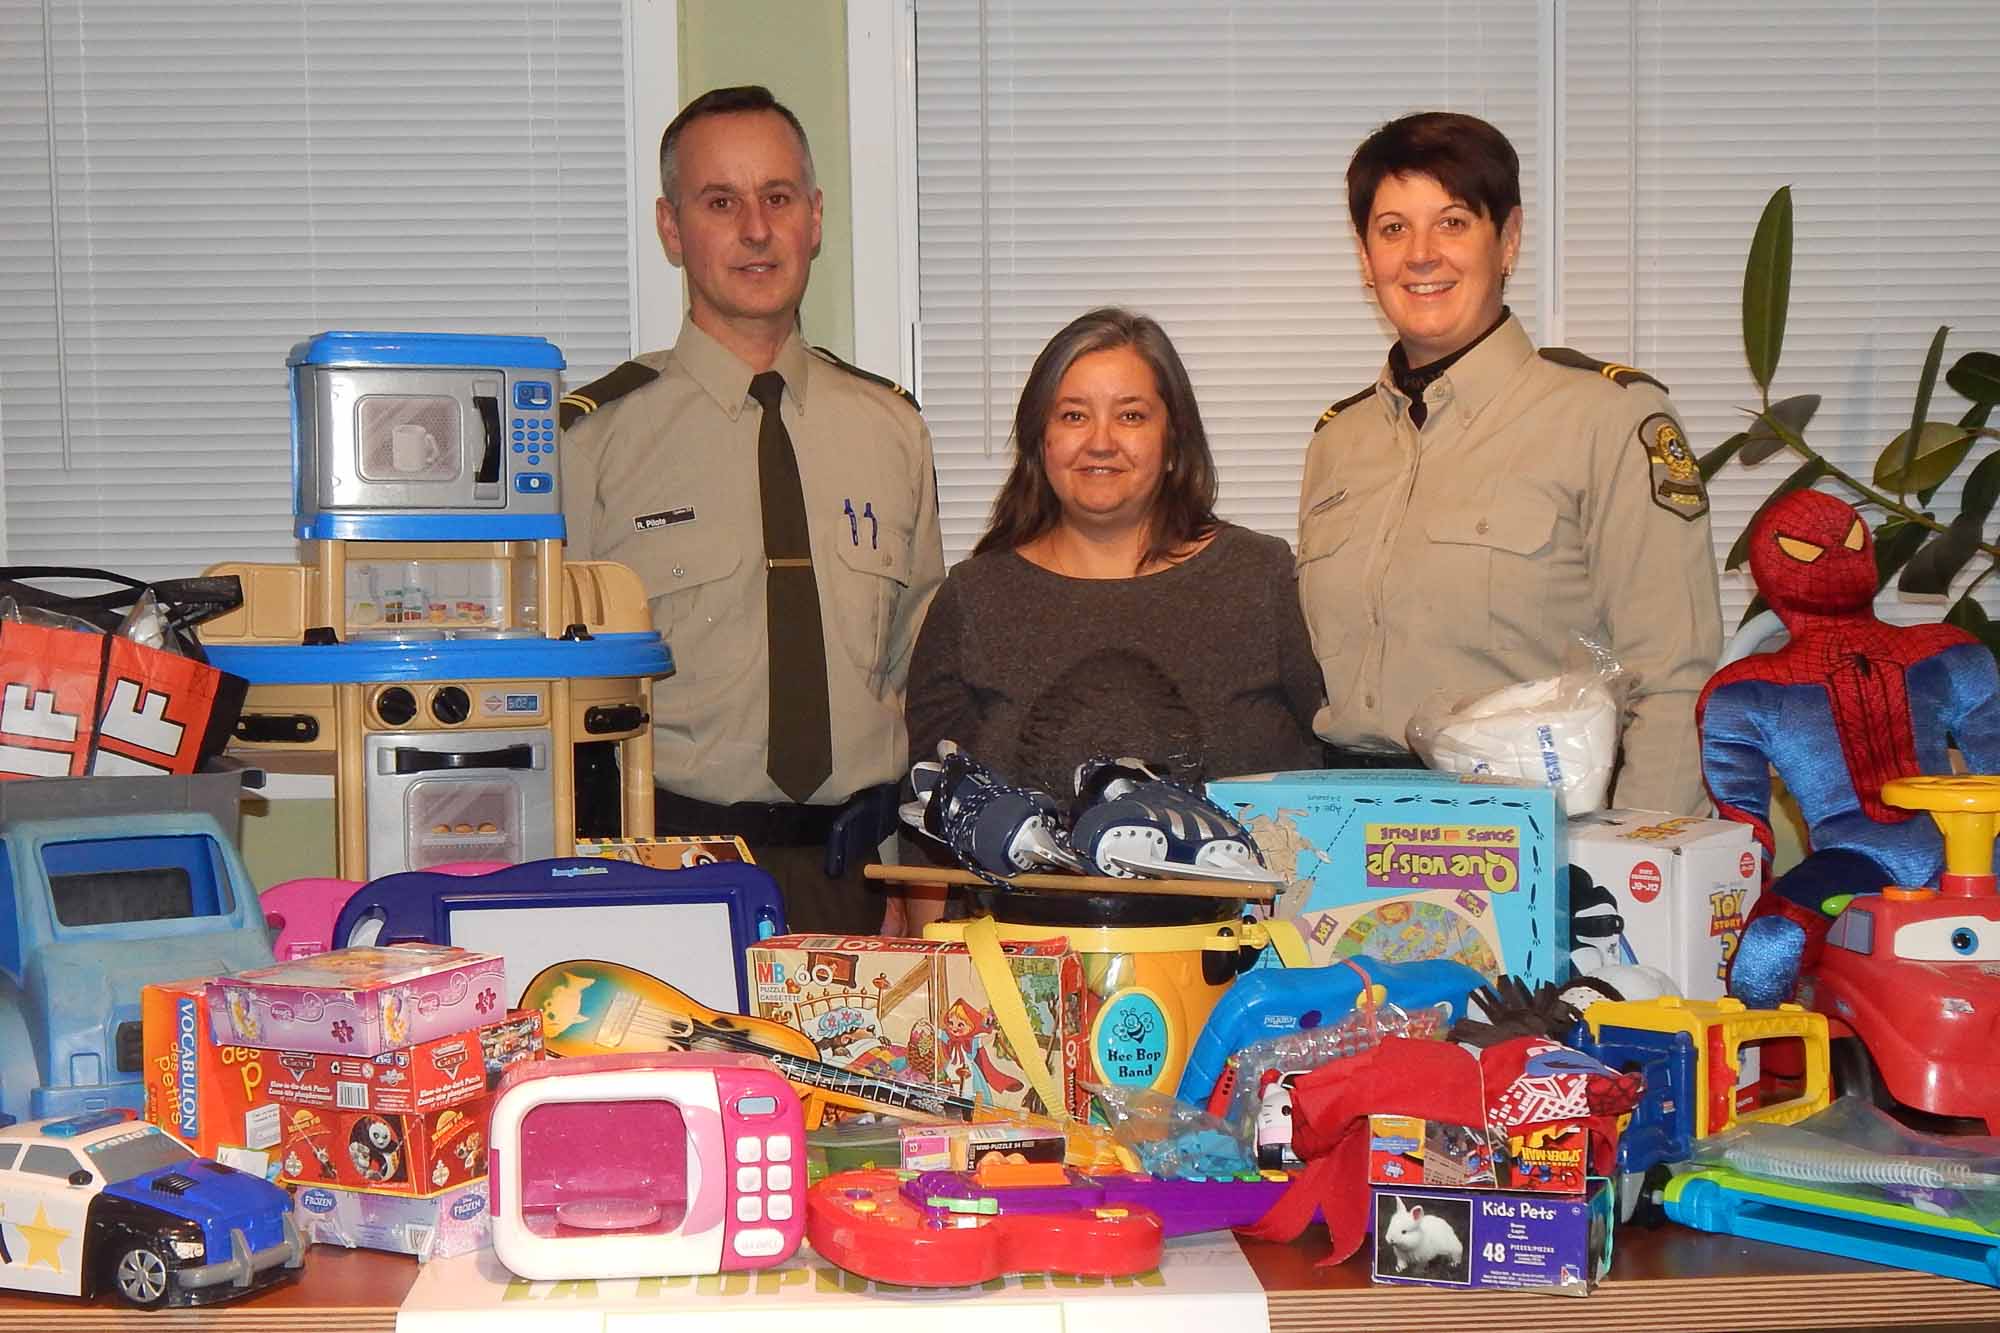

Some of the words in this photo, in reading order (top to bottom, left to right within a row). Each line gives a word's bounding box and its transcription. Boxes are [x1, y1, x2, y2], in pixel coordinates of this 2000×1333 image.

[1365, 842, 1448, 884] vois-je
[1450, 849, 1519, 894] Que
[1709, 888, 1748, 918] TOY
[1713, 917, 1741, 930] STORY
[757, 963, 786, 984] MB
[794, 963, 833, 987] 60
[170, 1042, 183, 1072] des
[1136, 1048, 1161, 1061] Bop
[180, 1002, 196, 1131] VOCABULON
[1119, 1064, 1153, 1078] Band
[153, 1055, 183, 1125] petits
[1520, 1146, 1583, 1162] SPIDER-MAN
[304, 1196, 332, 1208] FROZEN
[454, 1200, 482, 1216] FROZEN
[1482, 1201, 1516, 1217] Kids
[1520, 1202, 1555, 1219] Pets
[1482, 1242, 1505, 1263] 48
